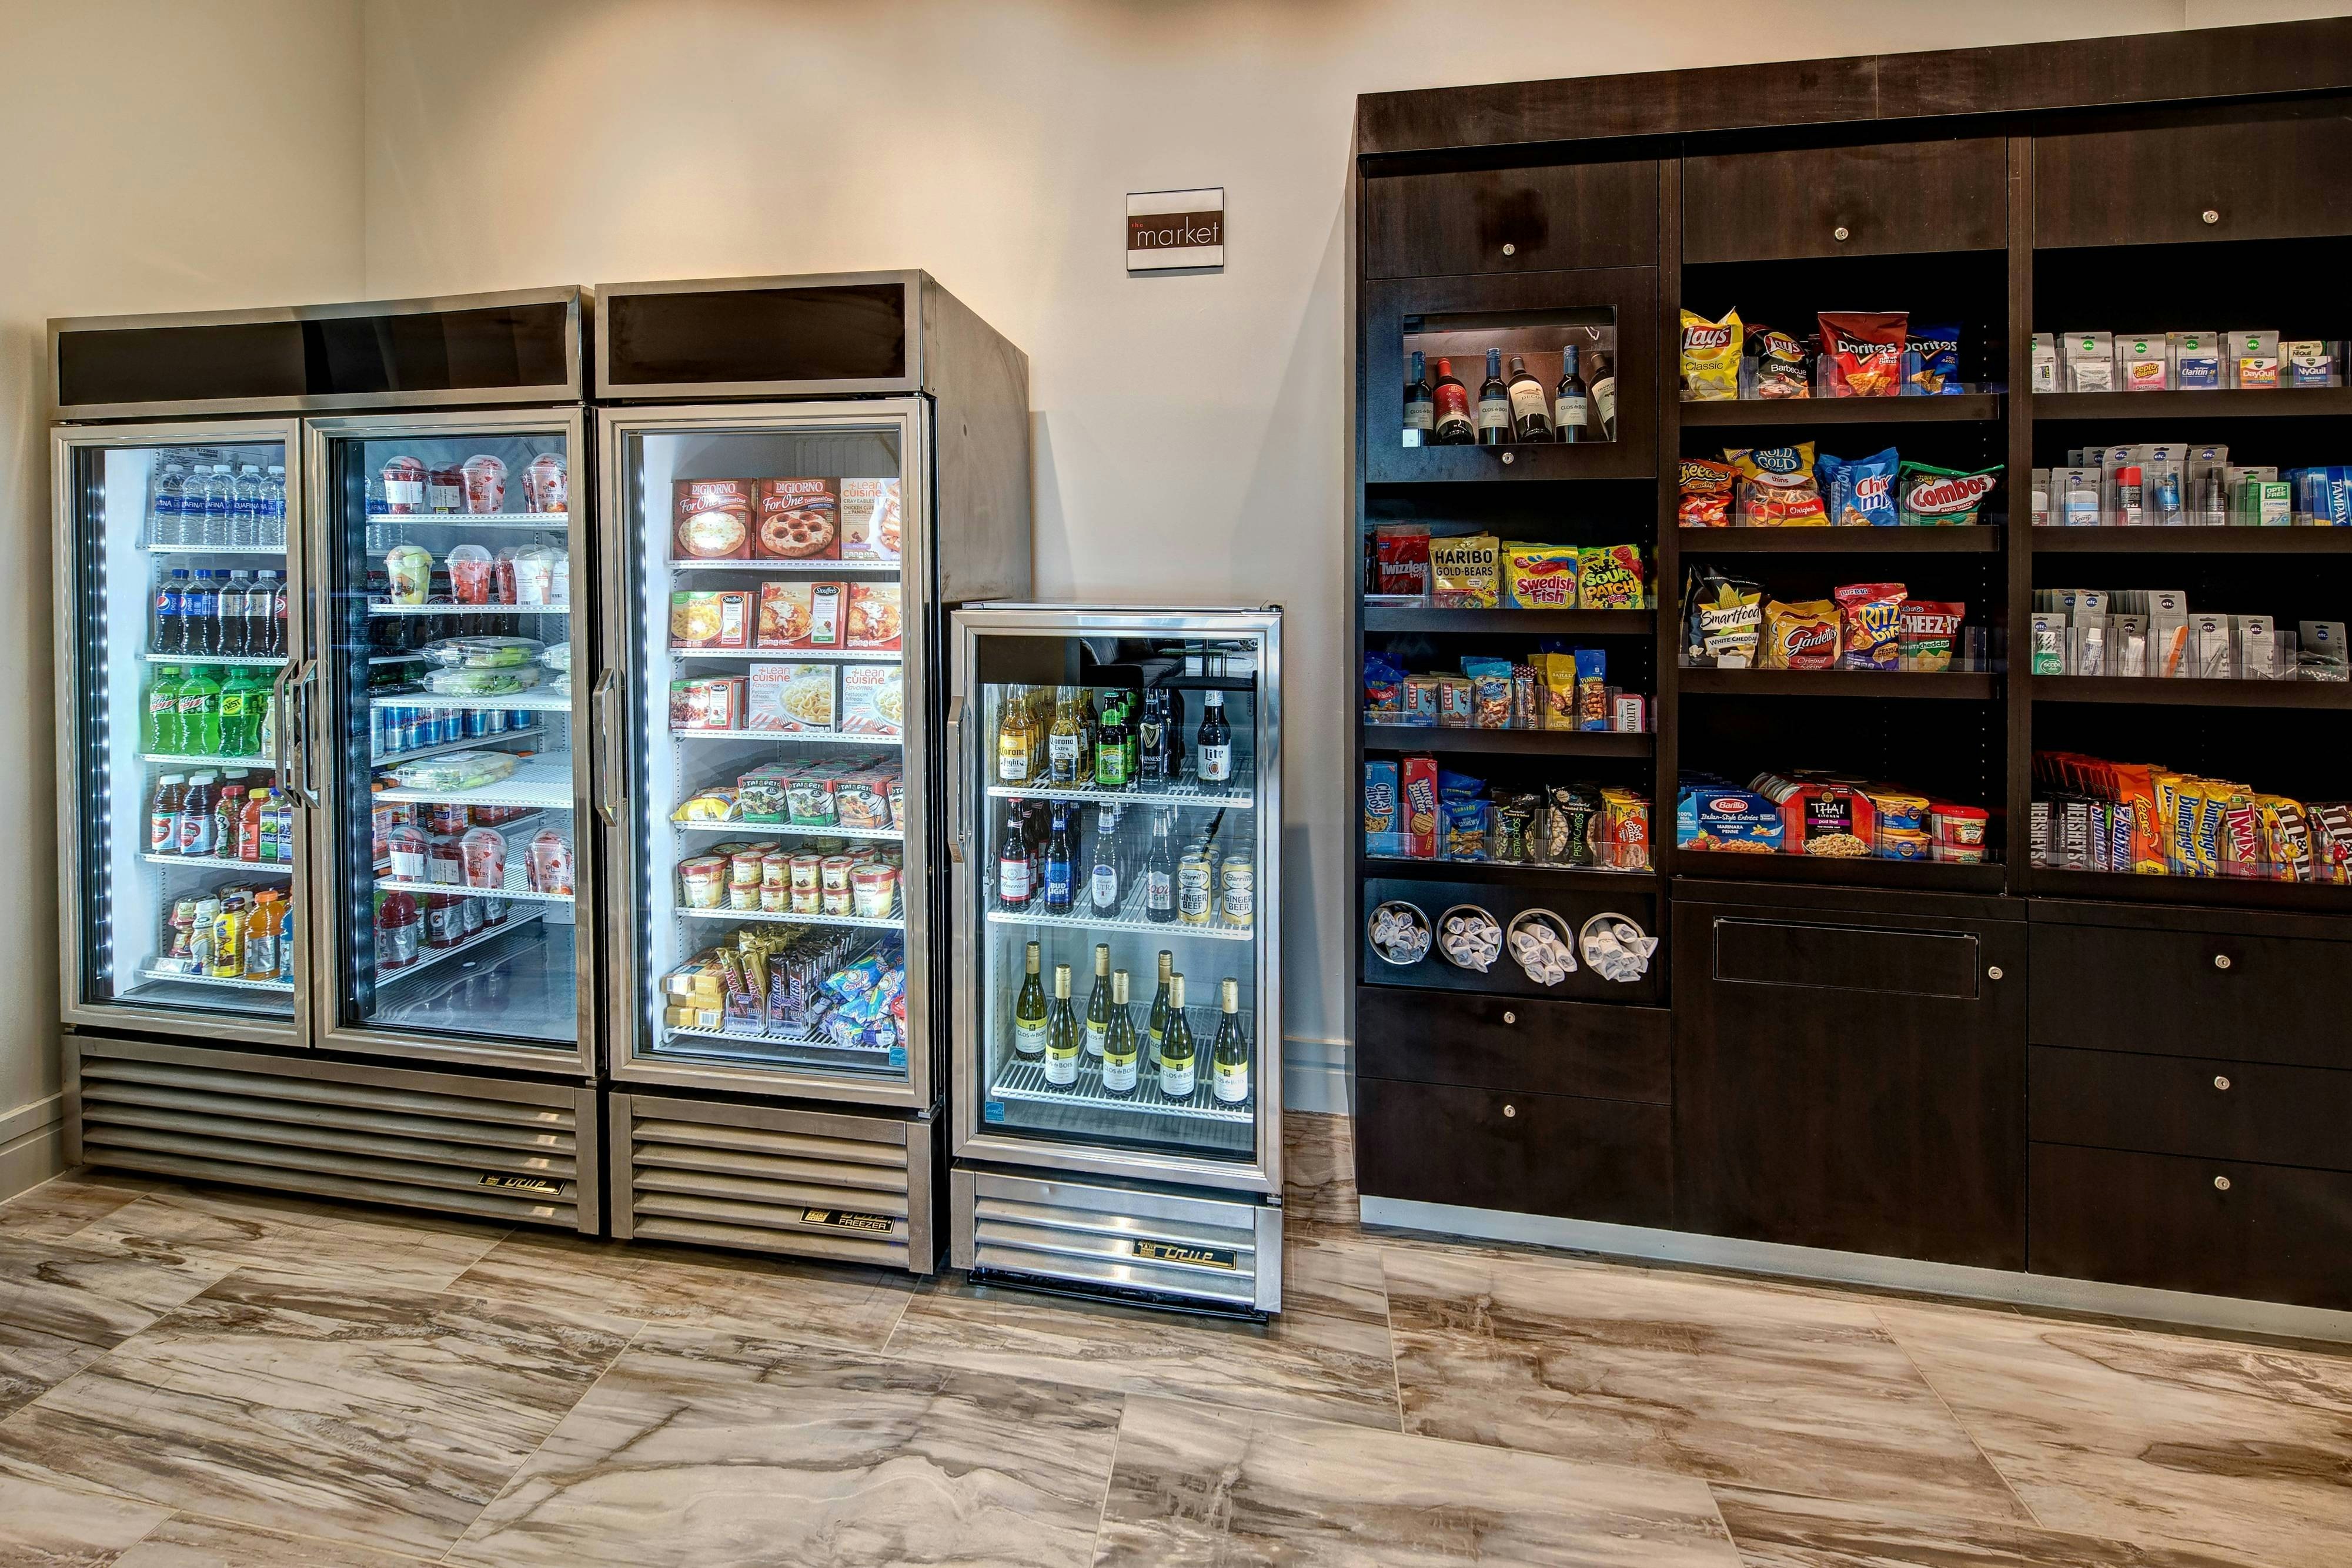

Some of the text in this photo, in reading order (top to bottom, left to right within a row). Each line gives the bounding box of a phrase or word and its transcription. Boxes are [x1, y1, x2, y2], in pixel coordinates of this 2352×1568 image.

[1137, 216, 1219, 246] market
[1684, 325, 1730, 349] Lay's
[1769, 336, 1800, 354] Lay's
[1838, 340, 1897, 354] Doritos
[1685, 362, 1723, 370] Classic
[1771, 364, 1807, 376] Barbecue
[2133, 363, 2159, 373] Pepto-
[2137, 369, 2159, 378] Bismol
[2243, 370, 2276, 378] DayQuil
[1760, 448, 1793, 458] ROLD
[1758, 457, 1797, 470] GOLD
[776, 482, 823, 494] DIGIORNO
[1913, 477, 1987, 507] Combos
[680, 499, 697, 513] For
[763, 494, 803, 512] For One
[2331, 479, 2347, 524] TAMPAX
[1789, 505, 1818, 514] Original
[1435, 550, 1492, 564] HARIBO
[1379, 560, 1428, 575] Twizzlers
[1436, 566, 1494, 576] GOLD-BEARS
[1586, 569, 1630, 586] SOUR
[1517, 576, 1576, 595] Swedish
[1585, 580, 1636, 601] PATCH
[1531, 589, 1565, 604] Fish
[1608, 594, 1628, 604] Kids
[1700, 605, 1759, 628] Smartfood
[1862, 605, 1899, 630] RITZ
[1709, 636, 1730, 646] WHITE
[1784, 626, 1837, 657] Gardetto's
[1919, 640, 1950, 649] cheddar
[1050, 736, 1074, 745] Corona
[1204, 748, 1224, 760] Lite
[1374, 783, 1391, 811] Chips
[1408, 783, 1427, 815] Butter
[1416, 778, 1434, 810] Nutter
[1452, 805, 1476, 814] PLANTERS
[1811, 803, 1843, 814] THAI
[2134, 793, 2154, 838] Reese's
[1458, 819, 1479, 827] CASHEWS
[1700, 813, 1736, 822] Italian-Style
[1573, 813, 1584, 857] PISTACHIOS
[1625, 820, 1637, 843] Batch
[1633, 823, 1644, 841] Soft
[2031, 803, 2049, 860] HERSHEY'S
[2067, 803, 2087, 861] HERSHEY'S
[2092, 806, 2109, 864] SNICKERS
[2176, 794, 2201, 867] Butterfinger
[2197, 798, 2229, 862] Butterfinger
[2225, 802, 2257, 863] TWIX
[1180, 893, 1207, 901] GINGER
[1225, 895, 1252, 903] GINGER
[430, 911, 444, 927] G
[1162, 1070, 1177, 1079] CLOS
[839, 1219, 887, 1229] FREEZER
